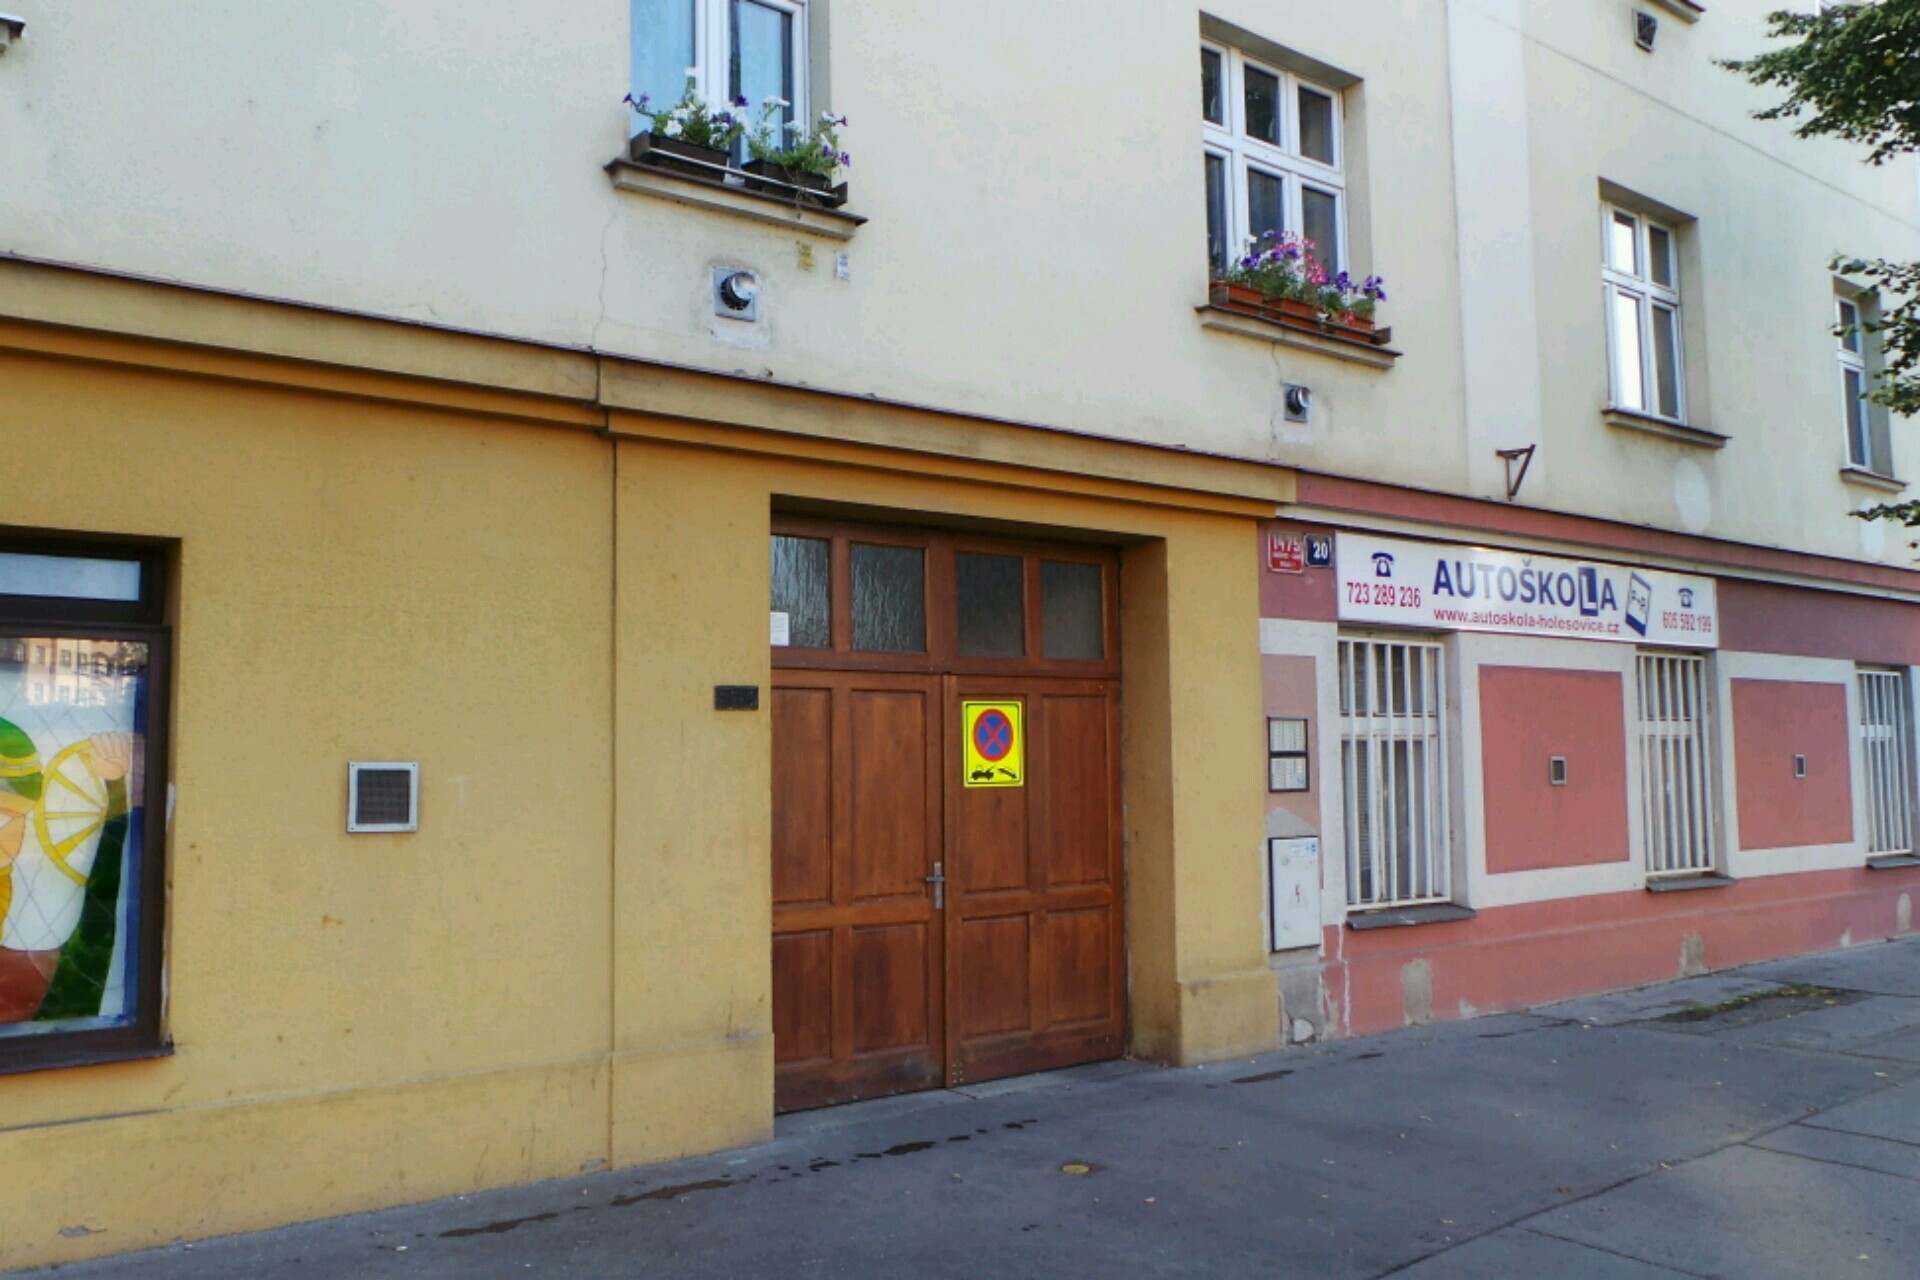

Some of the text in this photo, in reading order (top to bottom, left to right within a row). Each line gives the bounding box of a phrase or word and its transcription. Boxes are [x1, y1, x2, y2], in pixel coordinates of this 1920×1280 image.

[1313, 541, 1328, 560] 20
[1347, 582, 1421, 609] 723 289 236
[1432, 558, 1618, 614] AUTOŠKOLA
[1433, 608, 1620, 635] www.autoskola-holesovice.cz
